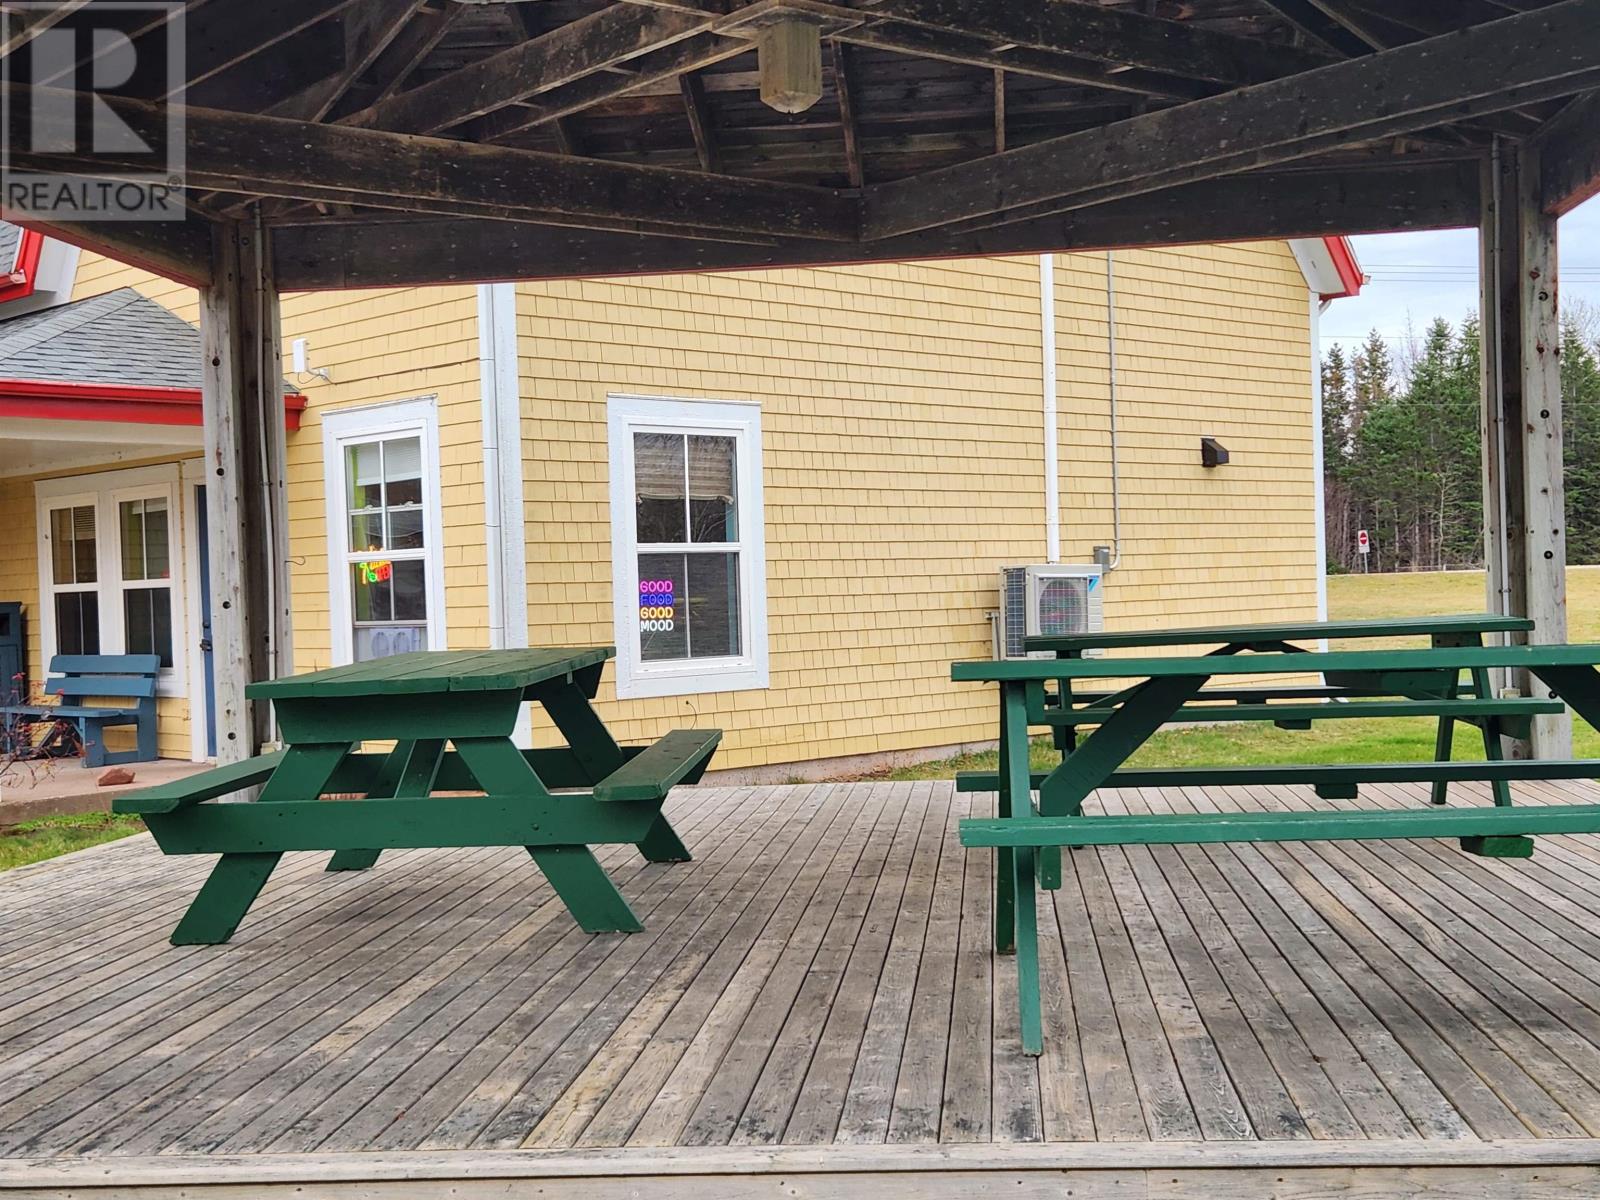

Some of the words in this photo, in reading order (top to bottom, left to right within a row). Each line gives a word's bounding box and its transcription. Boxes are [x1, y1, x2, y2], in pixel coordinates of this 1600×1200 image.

[640, 581, 673, 593] GOOD
[640, 594, 673, 606] FOOD
[640, 607, 674, 619] GOOD
[640, 620, 674, 632] MOOD
